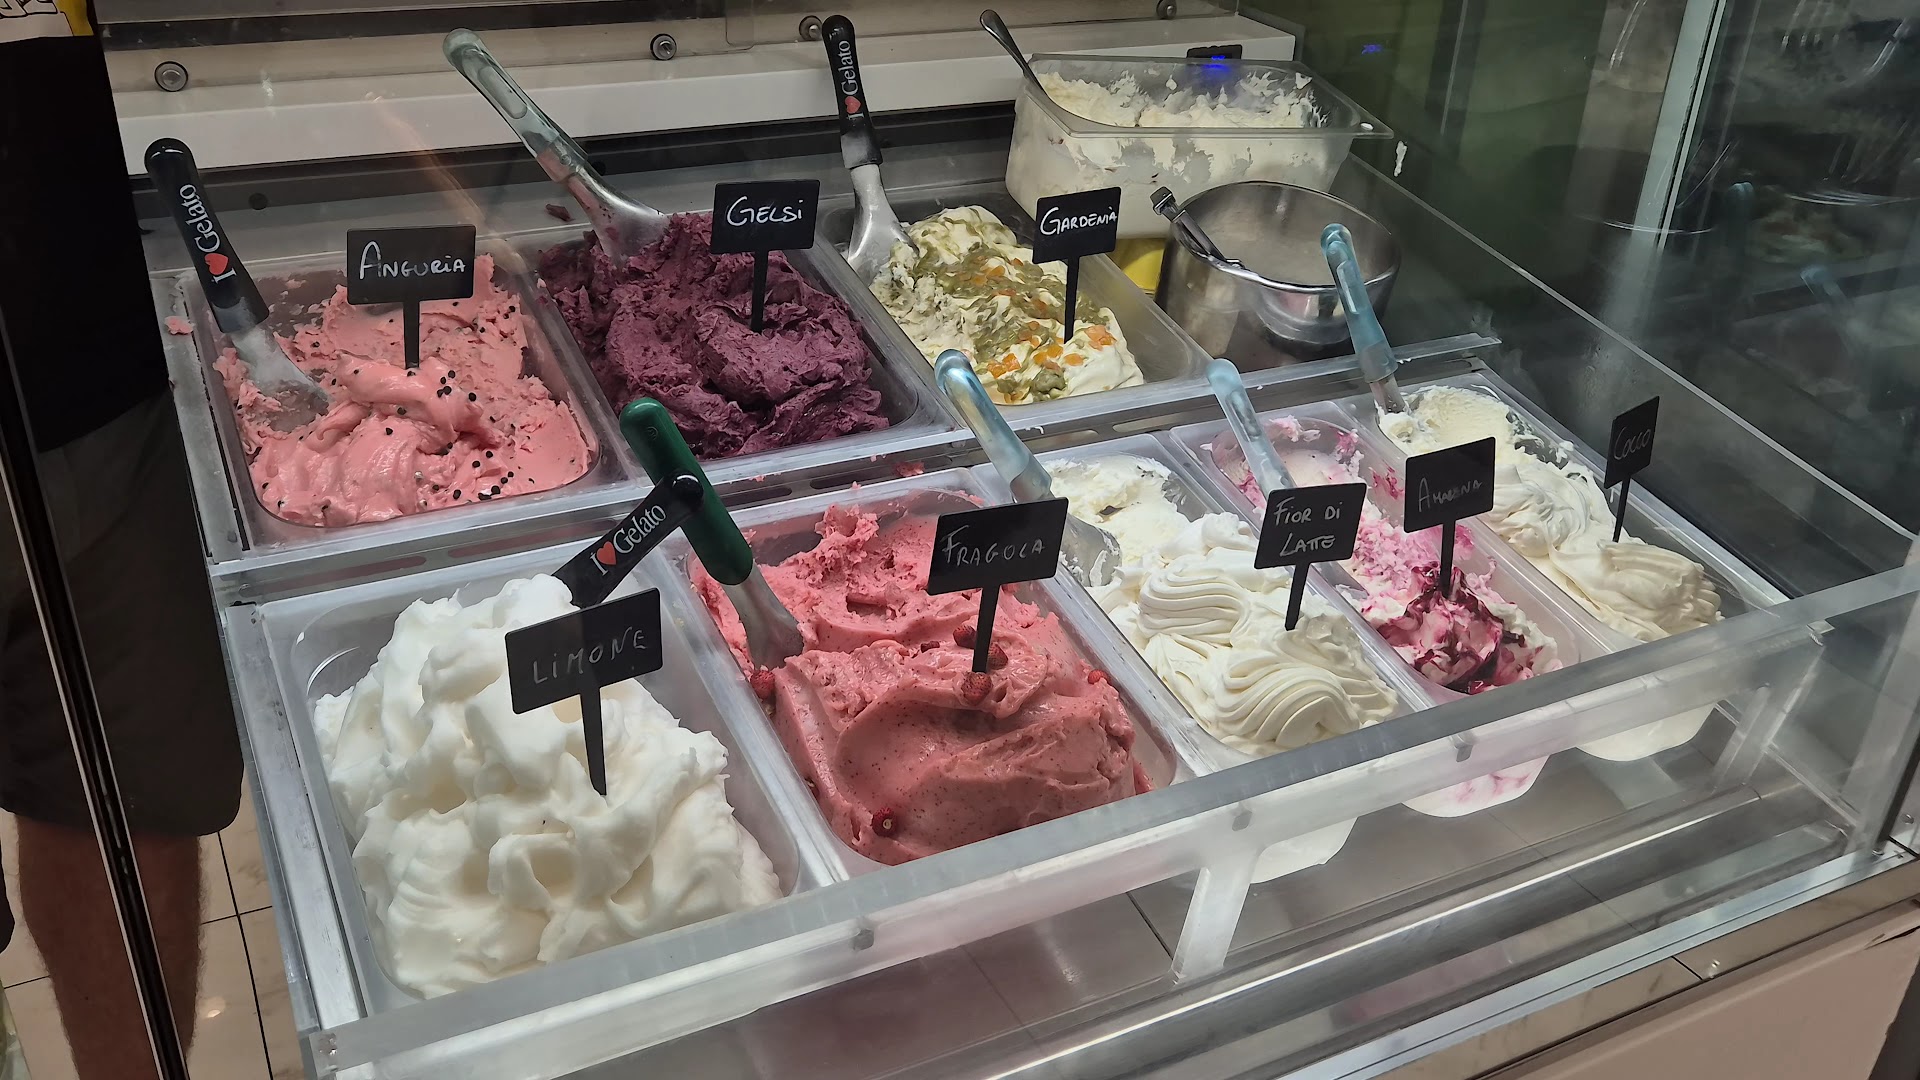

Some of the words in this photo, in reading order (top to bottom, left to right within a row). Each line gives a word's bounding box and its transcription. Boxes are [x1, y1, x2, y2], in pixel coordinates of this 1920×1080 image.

[839, 40, 859, 96] Gelato
[847, 111, 865, 121] I
[179, 184, 221, 253] Gelato
[211, 267, 237, 285] I
[589, 551, 609, 576] I
[612, 504, 667, 554] Gelato
[941, 524, 1045, 567] FRAGOLA
